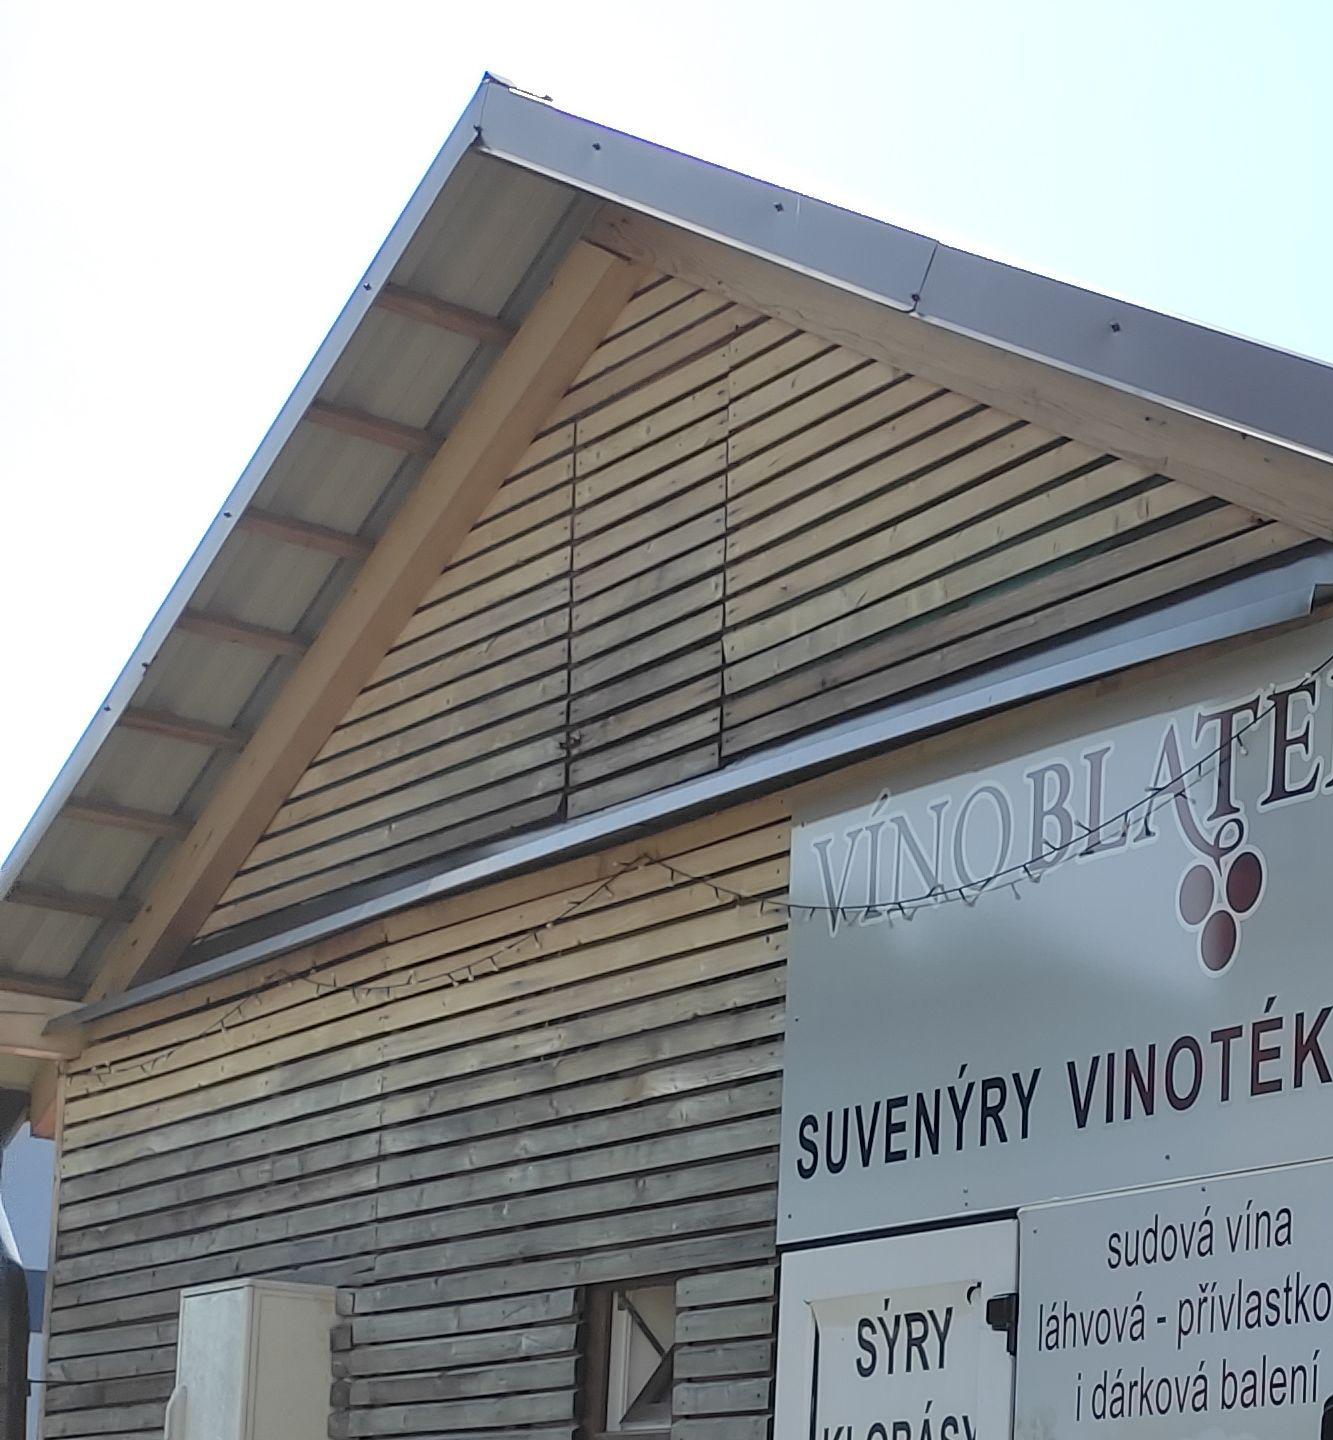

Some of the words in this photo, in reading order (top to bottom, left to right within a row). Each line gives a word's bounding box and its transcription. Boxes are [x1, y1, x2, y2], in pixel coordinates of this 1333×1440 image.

[797, 1063, 1042, 1180] SUVENÝRY
[1107, 1205, 1214, 1269] sudová
[1227, 1199, 1294, 1252] vína
[855, 1298, 954, 1379] SÝRY
[1037, 1293, 1147, 1353] láhvová
[1075, 1375, 1083, 1423] i
[1091, 1361, 1209, 1421] dárková
[1220, 1349, 1322, 1412] balení
